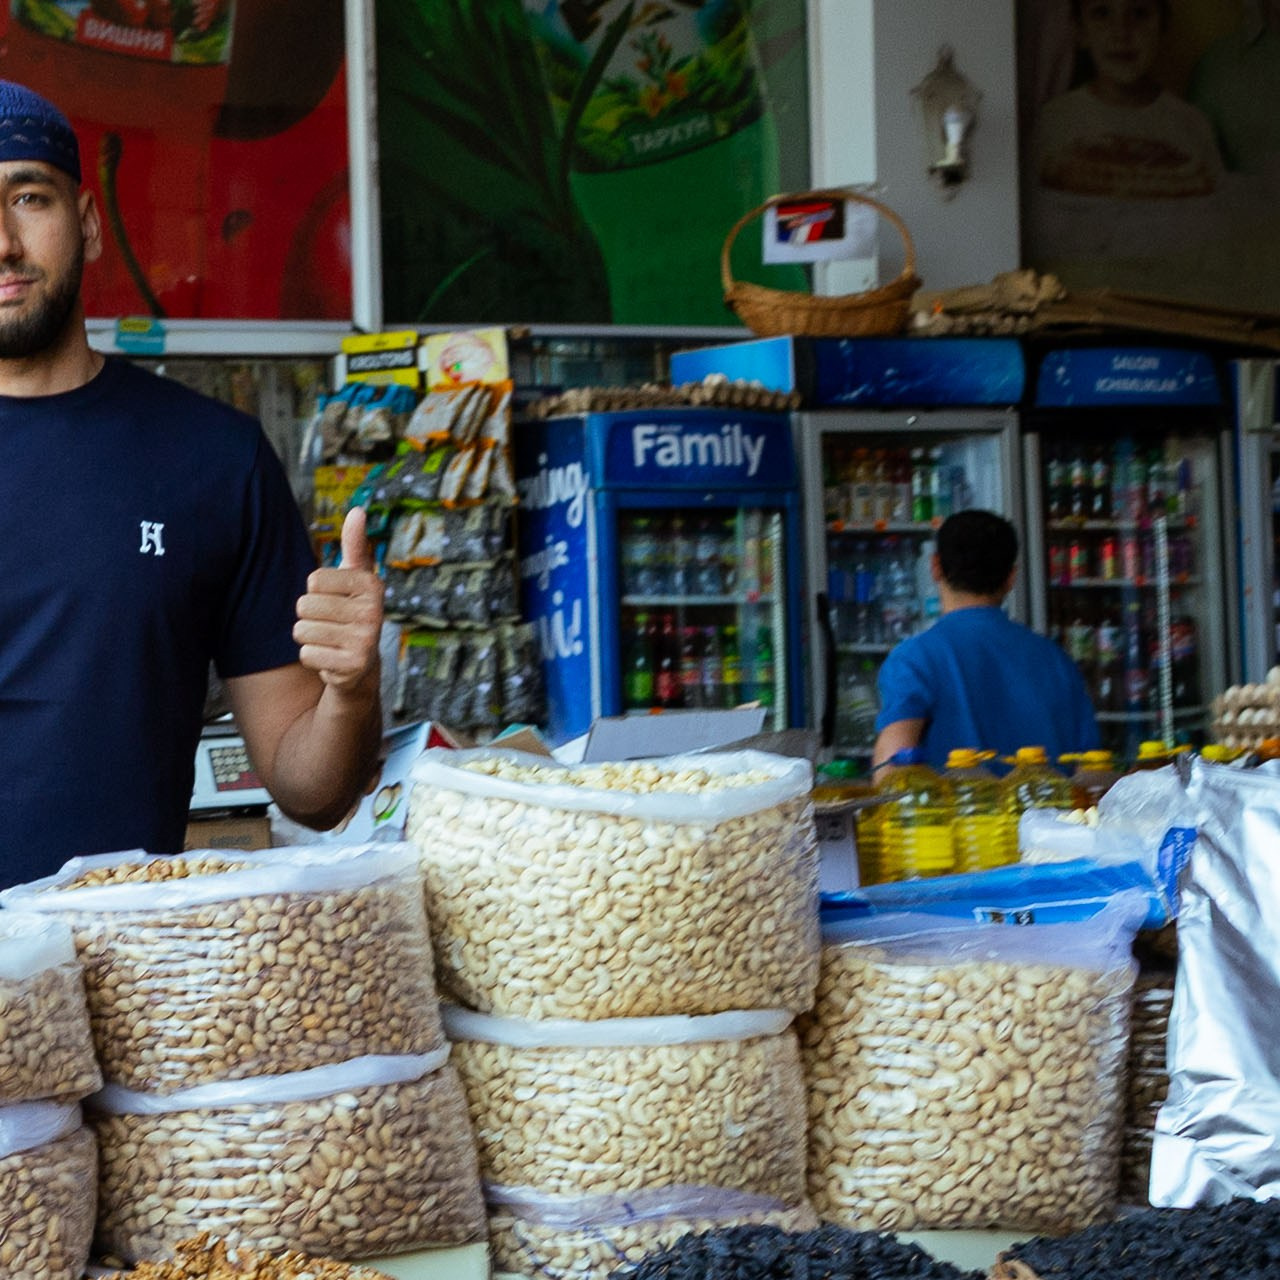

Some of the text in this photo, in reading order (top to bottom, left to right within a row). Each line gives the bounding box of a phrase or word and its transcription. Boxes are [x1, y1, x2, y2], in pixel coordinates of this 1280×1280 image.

[84, 18, 165, 51] ВИШНЯ
[630, 115, 711, 154] ТАРХУН
[632, 422, 766, 477] Family
